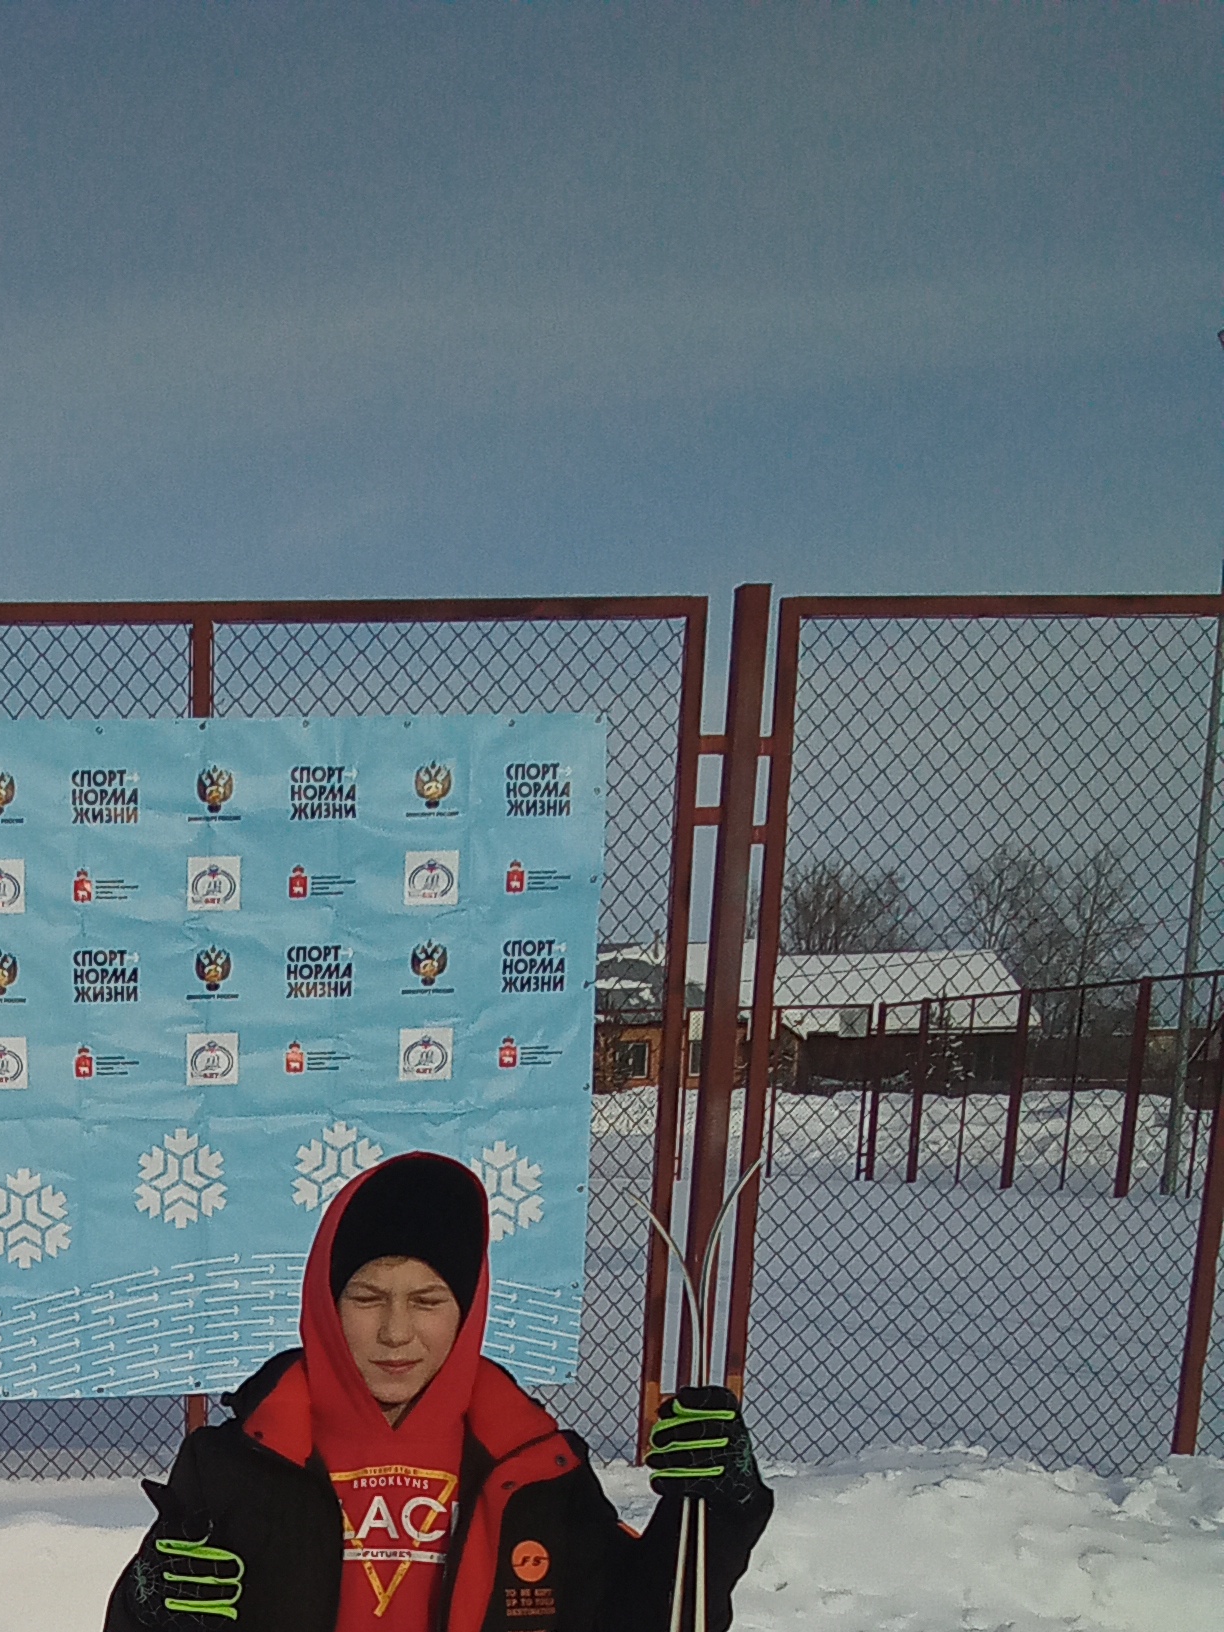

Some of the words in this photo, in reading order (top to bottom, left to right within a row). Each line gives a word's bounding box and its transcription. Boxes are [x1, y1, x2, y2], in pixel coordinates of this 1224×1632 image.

[72, 769, 126, 787] СПОРТ
[290, 766, 345, 783] СПОРТ
[506, 763, 560, 780] СПОРТ
[72, 788, 138, 806] НОРМА
[290, 784, 356, 802] НОРМА
[506, 781, 571, 798] НОРМА
[72, 807, 138, 824] ЖИЗНИ
[289, 803, 356, 820] ЖИЗНИ
[506, 799, 571, 816] ЖИЗНИ
[287, 945, 342, 962] СПОРТ
[503, 940, 556, 957] СПОРТ
[73, 950, 127, 967] СПОРТ
[502, 958, 565, 975] НОРМА
[74, 967, 138, 985] НОРМА
[286, 963, 352, 980] НОРМА
[286, 981, 352, 998] ЖИЗНИ
[501, 975, 565, 993] ЖИЗНИ
[74, 985, 138, 1003] ЖИЗНИ
